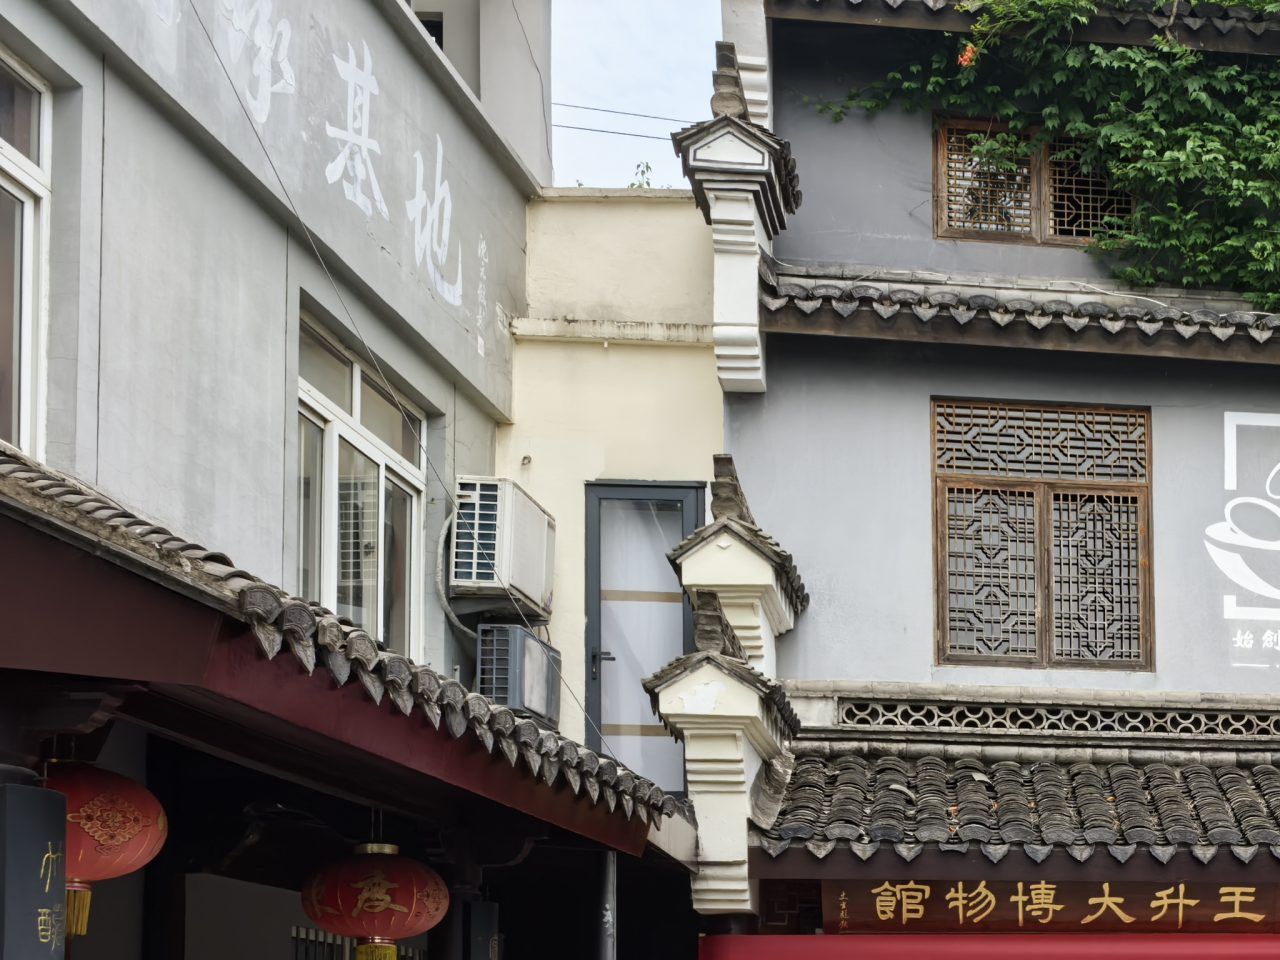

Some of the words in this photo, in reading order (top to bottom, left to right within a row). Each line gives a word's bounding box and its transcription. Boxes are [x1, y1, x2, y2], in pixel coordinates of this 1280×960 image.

[870, 880, 1265, 926] 王升大博物館
